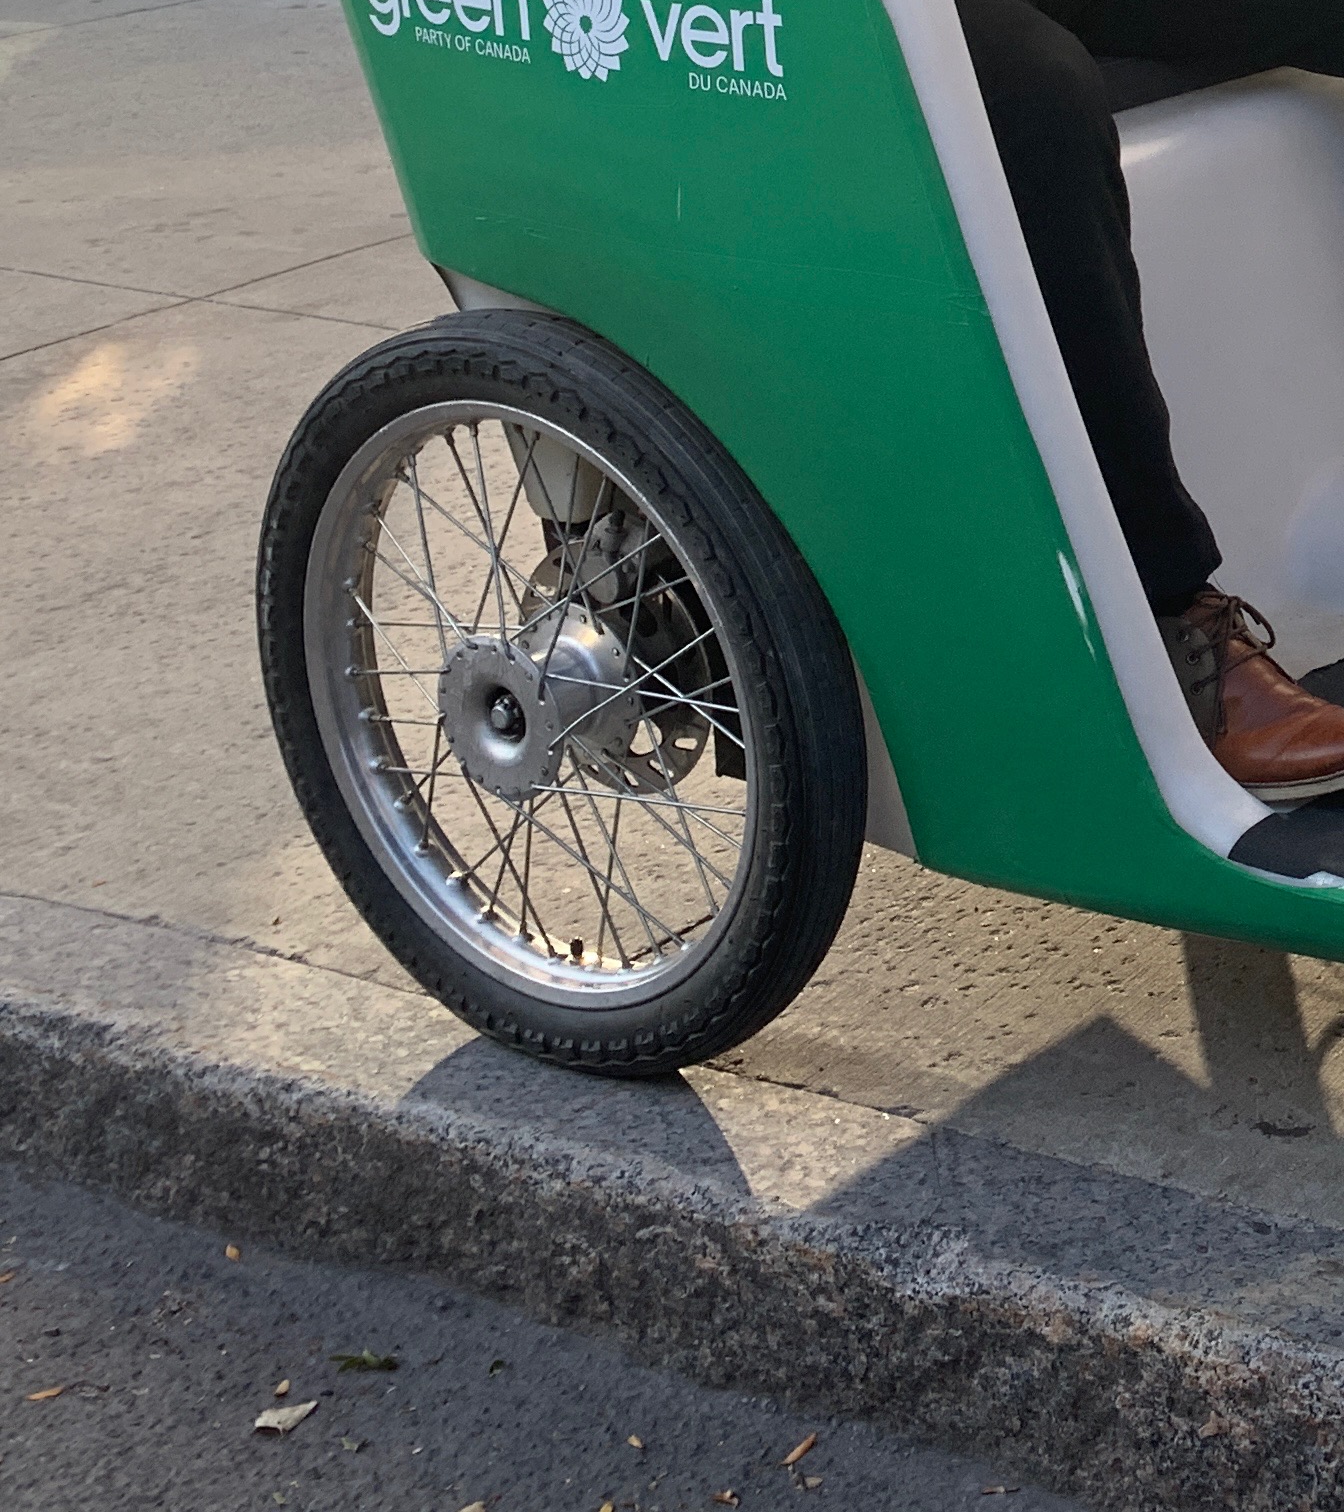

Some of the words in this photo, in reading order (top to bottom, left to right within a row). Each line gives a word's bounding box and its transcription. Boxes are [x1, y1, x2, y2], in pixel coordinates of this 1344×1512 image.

[415, 26, 452, 50] PARTY
[454, 33, 474, 53] OF
[475, 38, 532, 64] CANADA
[688, 71, 712, 92] DU
[716, 75, 788, 101] CANADA
